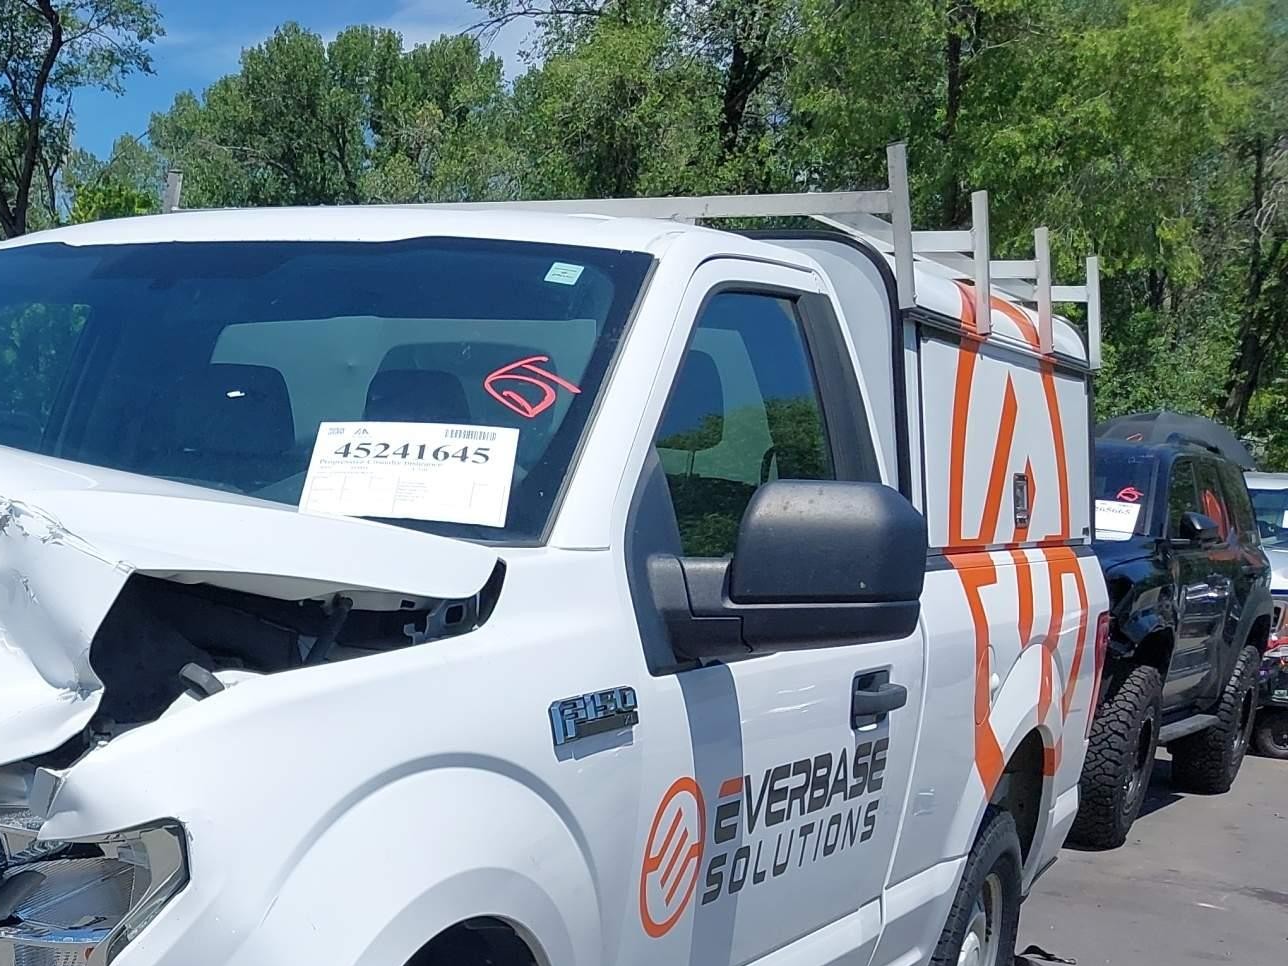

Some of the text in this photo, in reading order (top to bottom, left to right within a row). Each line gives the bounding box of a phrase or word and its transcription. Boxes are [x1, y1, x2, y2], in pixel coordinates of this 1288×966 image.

[334, 442, 491, 464] 45241645
[714, 737, 889, 845] EVERBASE
[702, 799, 880, 906] SOLUTIONS
